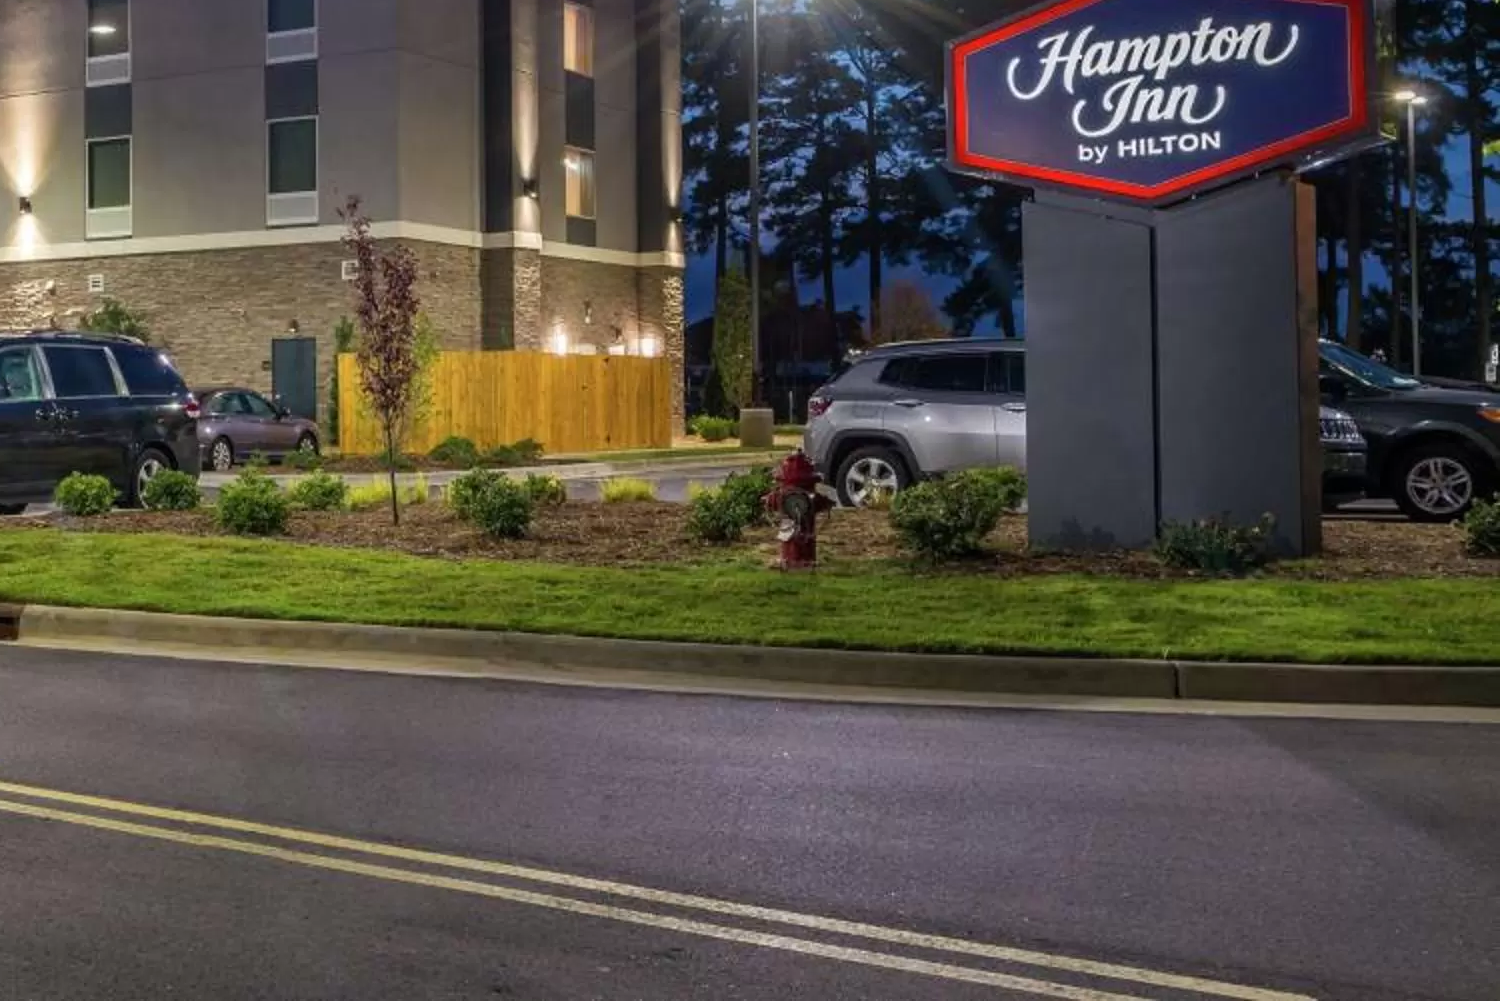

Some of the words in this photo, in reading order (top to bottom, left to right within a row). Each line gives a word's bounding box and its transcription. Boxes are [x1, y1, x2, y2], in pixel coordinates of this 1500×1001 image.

[1007, 17, 1299, 100] Hampton
[1072, 74, 1225, 137] Inn
[1078, 144, 1108, 164] by
[1118, 131, 1221, 158] HILTON
